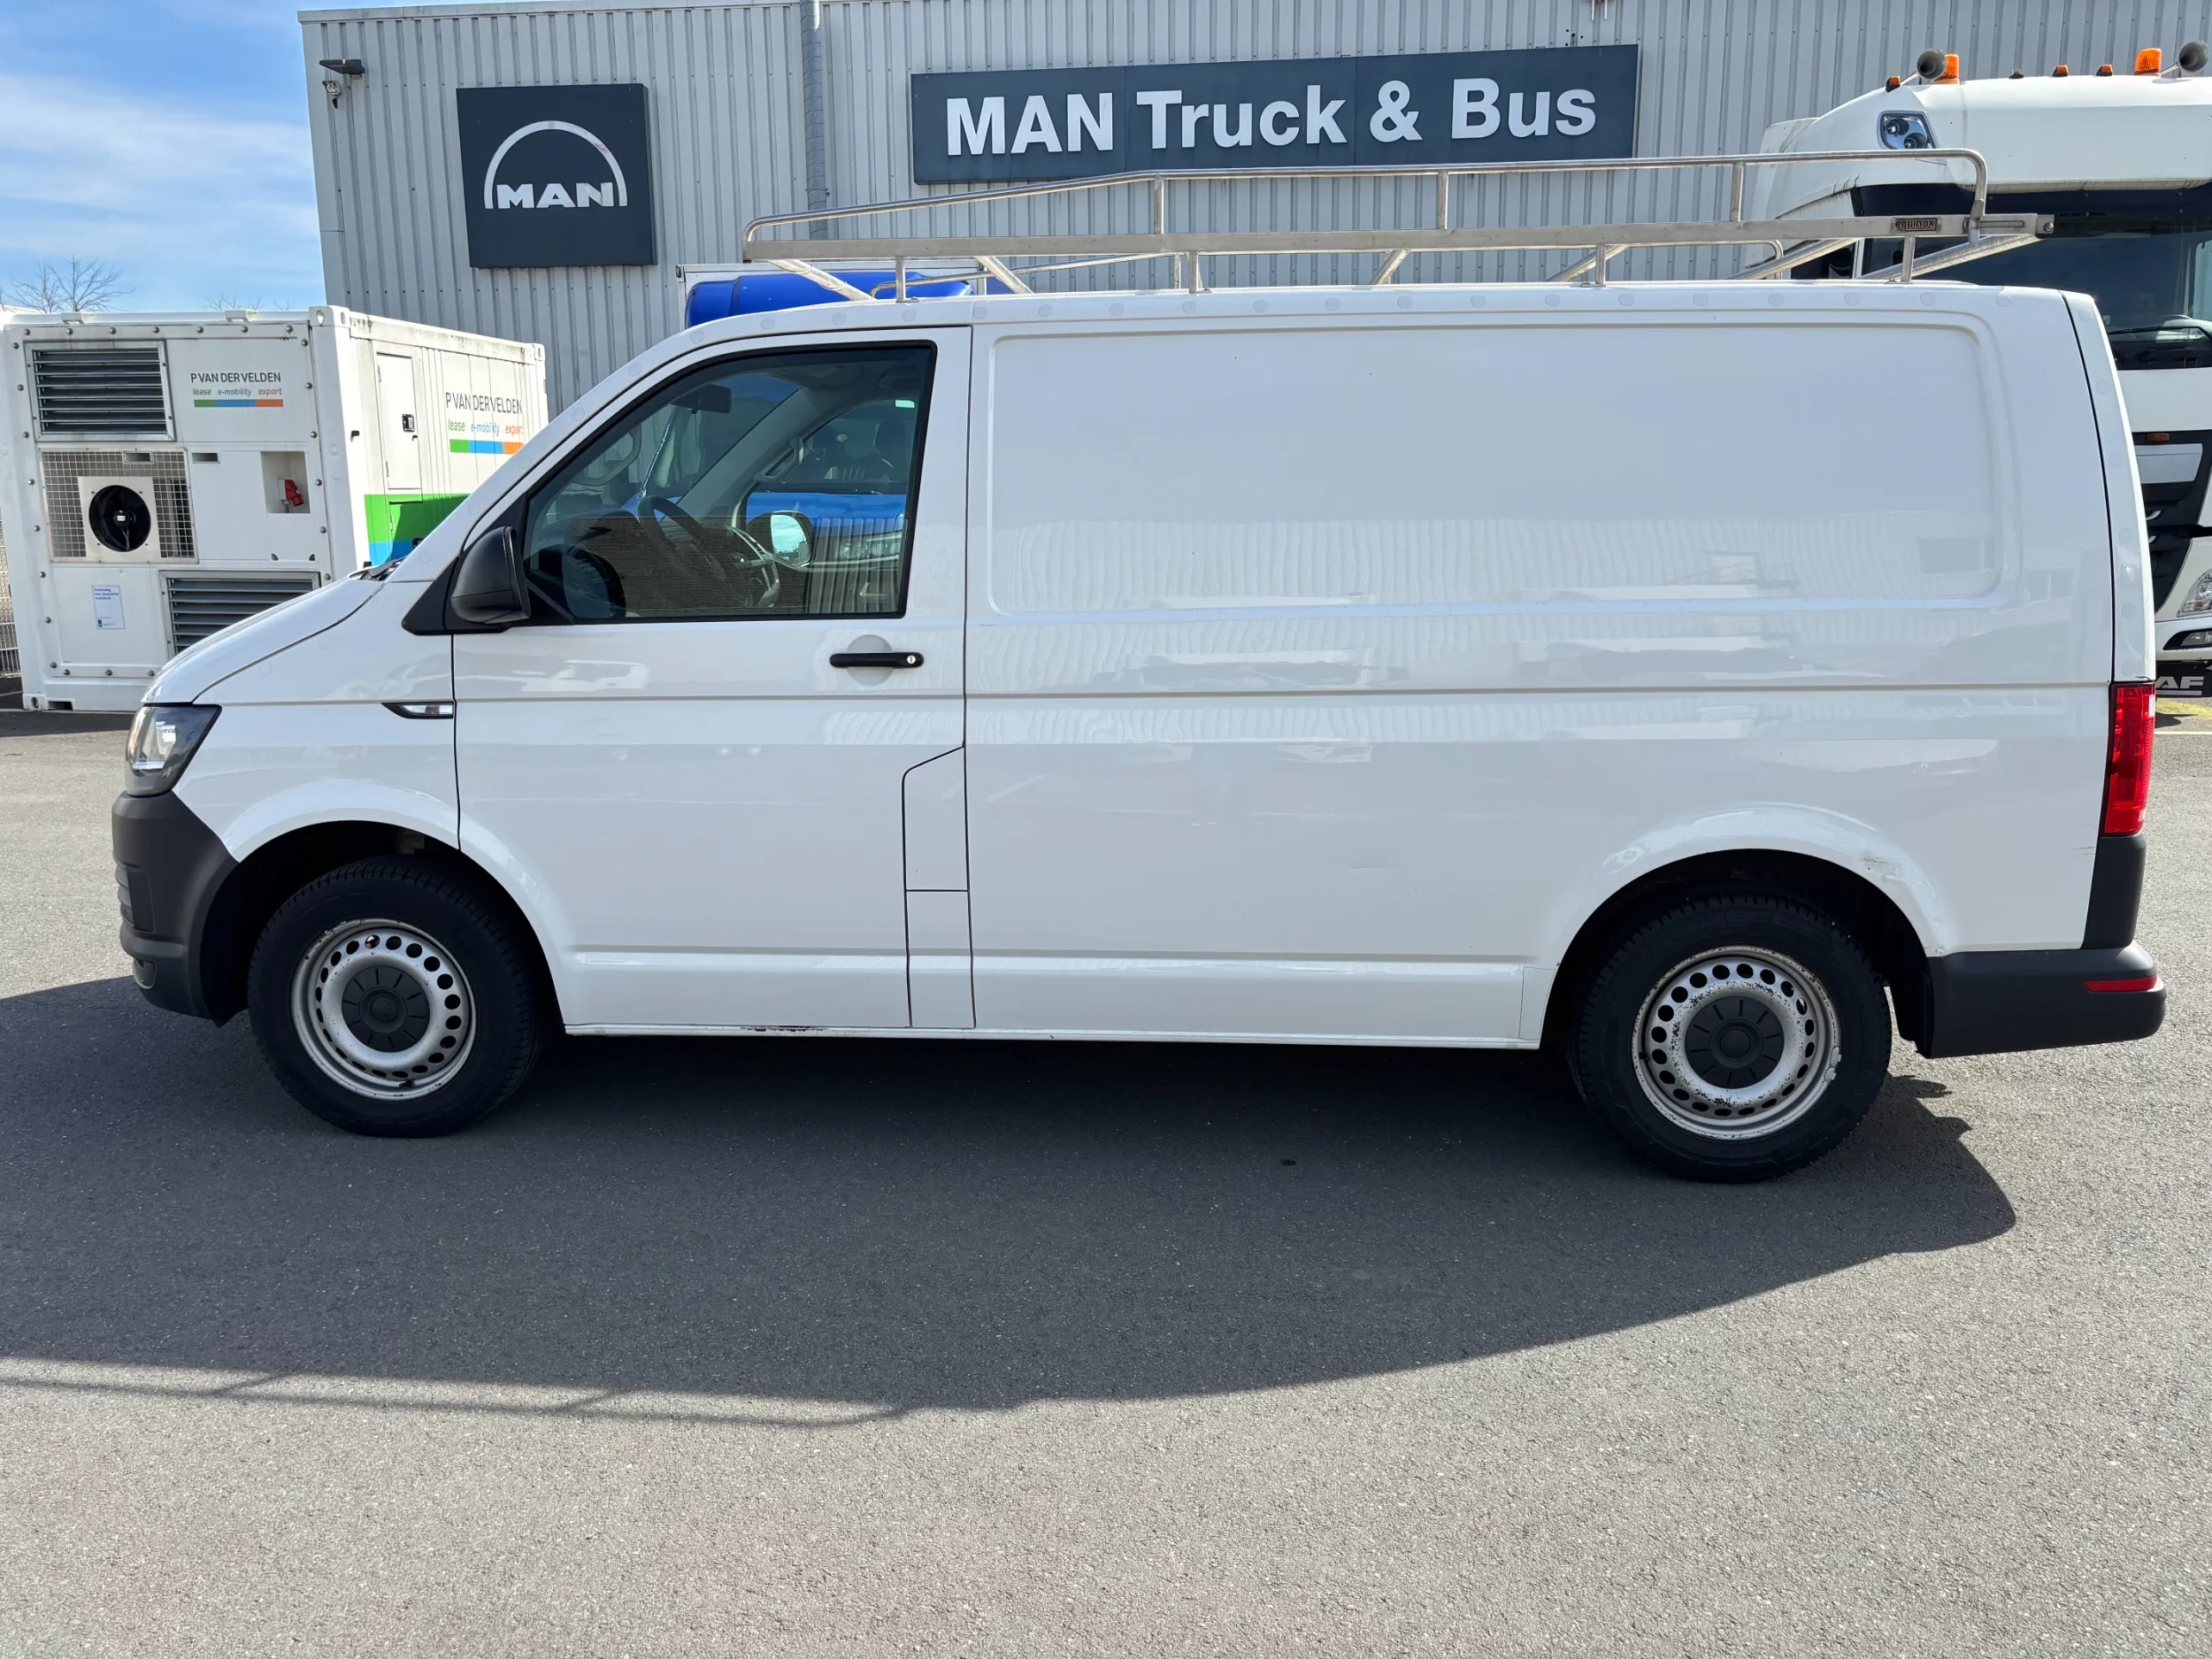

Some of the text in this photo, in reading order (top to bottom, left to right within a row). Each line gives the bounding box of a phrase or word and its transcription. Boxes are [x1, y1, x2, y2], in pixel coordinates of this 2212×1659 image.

[947, 78, 1596, 156] MAN Truck & Bus
[496, 182, 614, 209] MAN
[190, 372, 281, 382] P VAN DER VELDEN
[218, 388, 251, 396] e-mobility
[258, 388, 282, 396] export
[445, 392, 522, 414] P VAN DER VELDEN
[448, 419, 465, 432] lease
[471, 422, 500, 436] e-mobility
[2155, 676, 2204, 689] AF
